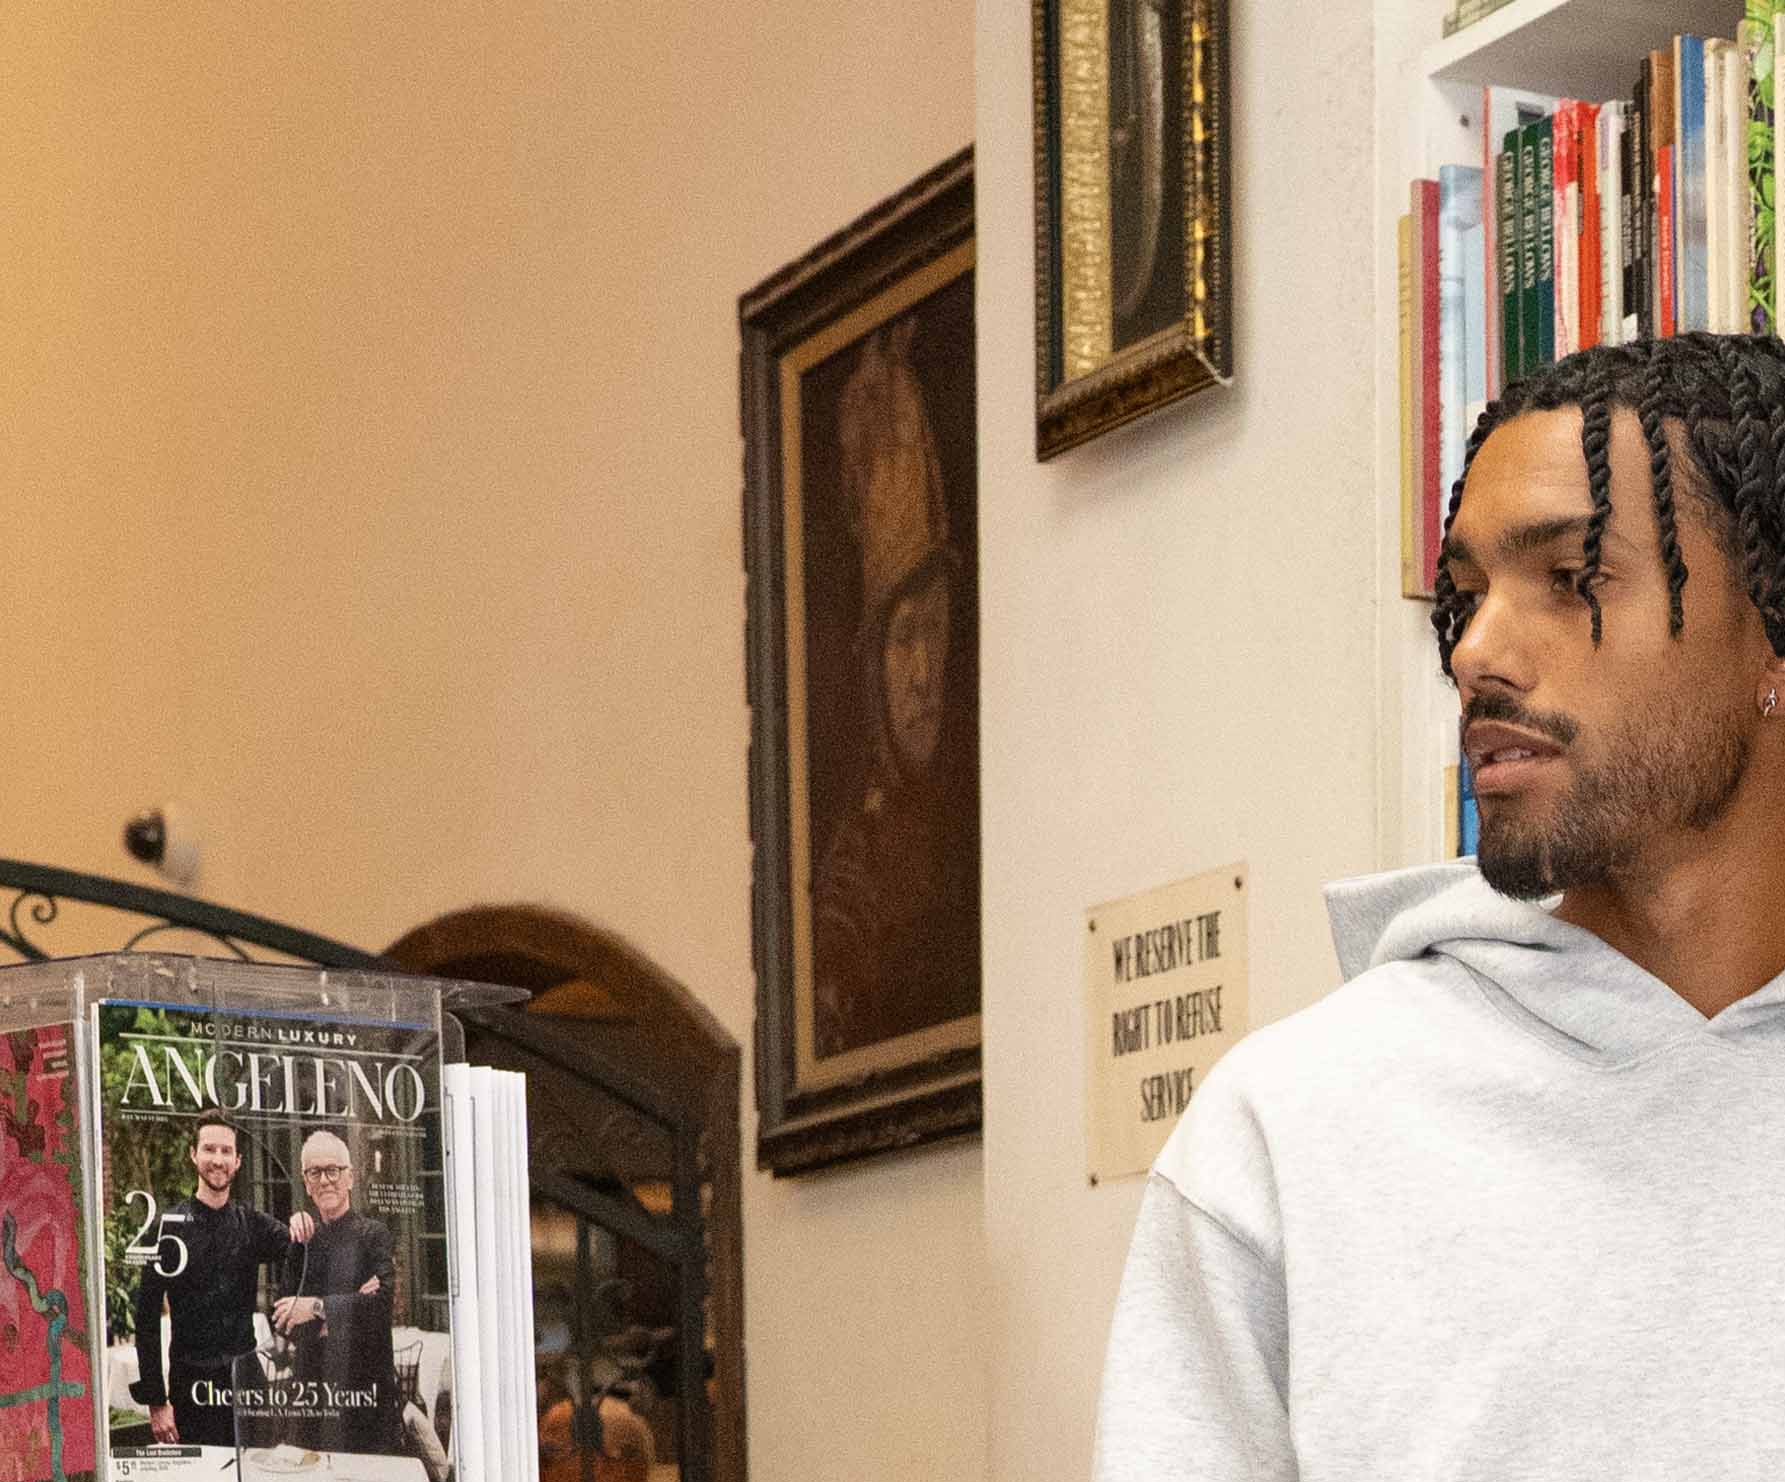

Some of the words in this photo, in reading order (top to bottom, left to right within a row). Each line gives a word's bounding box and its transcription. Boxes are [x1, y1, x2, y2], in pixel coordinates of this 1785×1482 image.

[1134, 919, 1192, 978] RESERVE
[1196, 910, 1221, 961] THE
[277, 1029, 357, 1046] LUXURY
[1113, 1005, 1150, 1058] RIGHT
[1156, 999, 1172, 1045] TO
[1176, 986, 1223, 1041] REFUSE
[121, 1044, 425, 1122] ANGELENO
[125, 1190, 188, 1277] 25
[268, 1383, 287, 1407] to
[292, 1383, 318, 1407] 25
[324, 1384, 377, 1408] Years!
